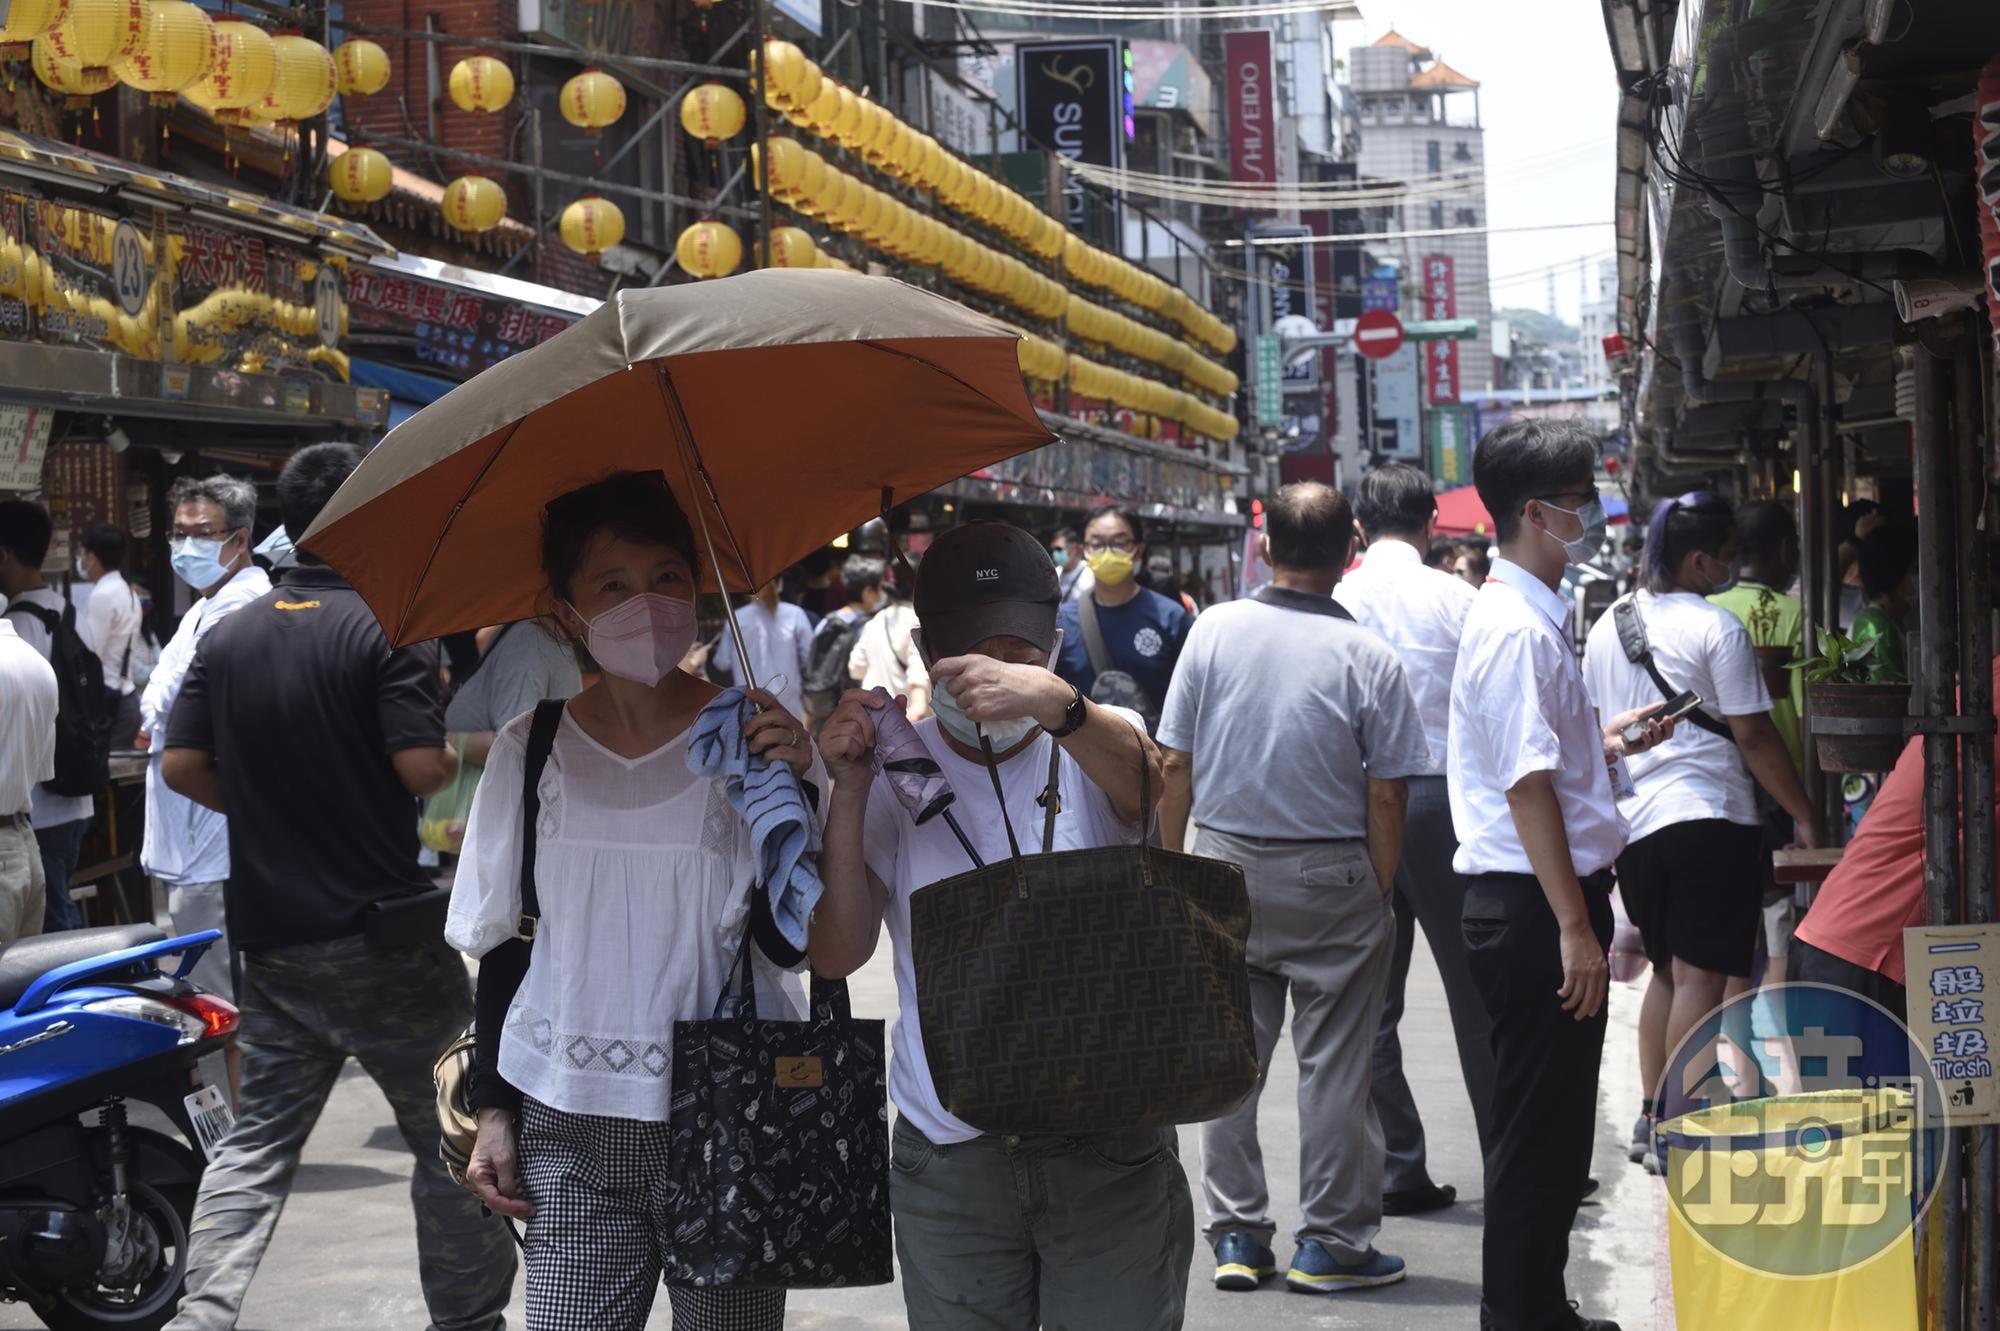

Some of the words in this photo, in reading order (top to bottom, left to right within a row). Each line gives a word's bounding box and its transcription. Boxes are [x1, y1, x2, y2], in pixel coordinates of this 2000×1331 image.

[1240, 61, 1266, 183] SHISEIDO
[118, 236, 141, 299] 23
[180, 223, 269, 295] 米粉湯
[976, 568, 999, 578] NYC
[1928, 942, 1989, 1057] 一般垃圾
[1930, 1055, 1992, 1081] Trash
